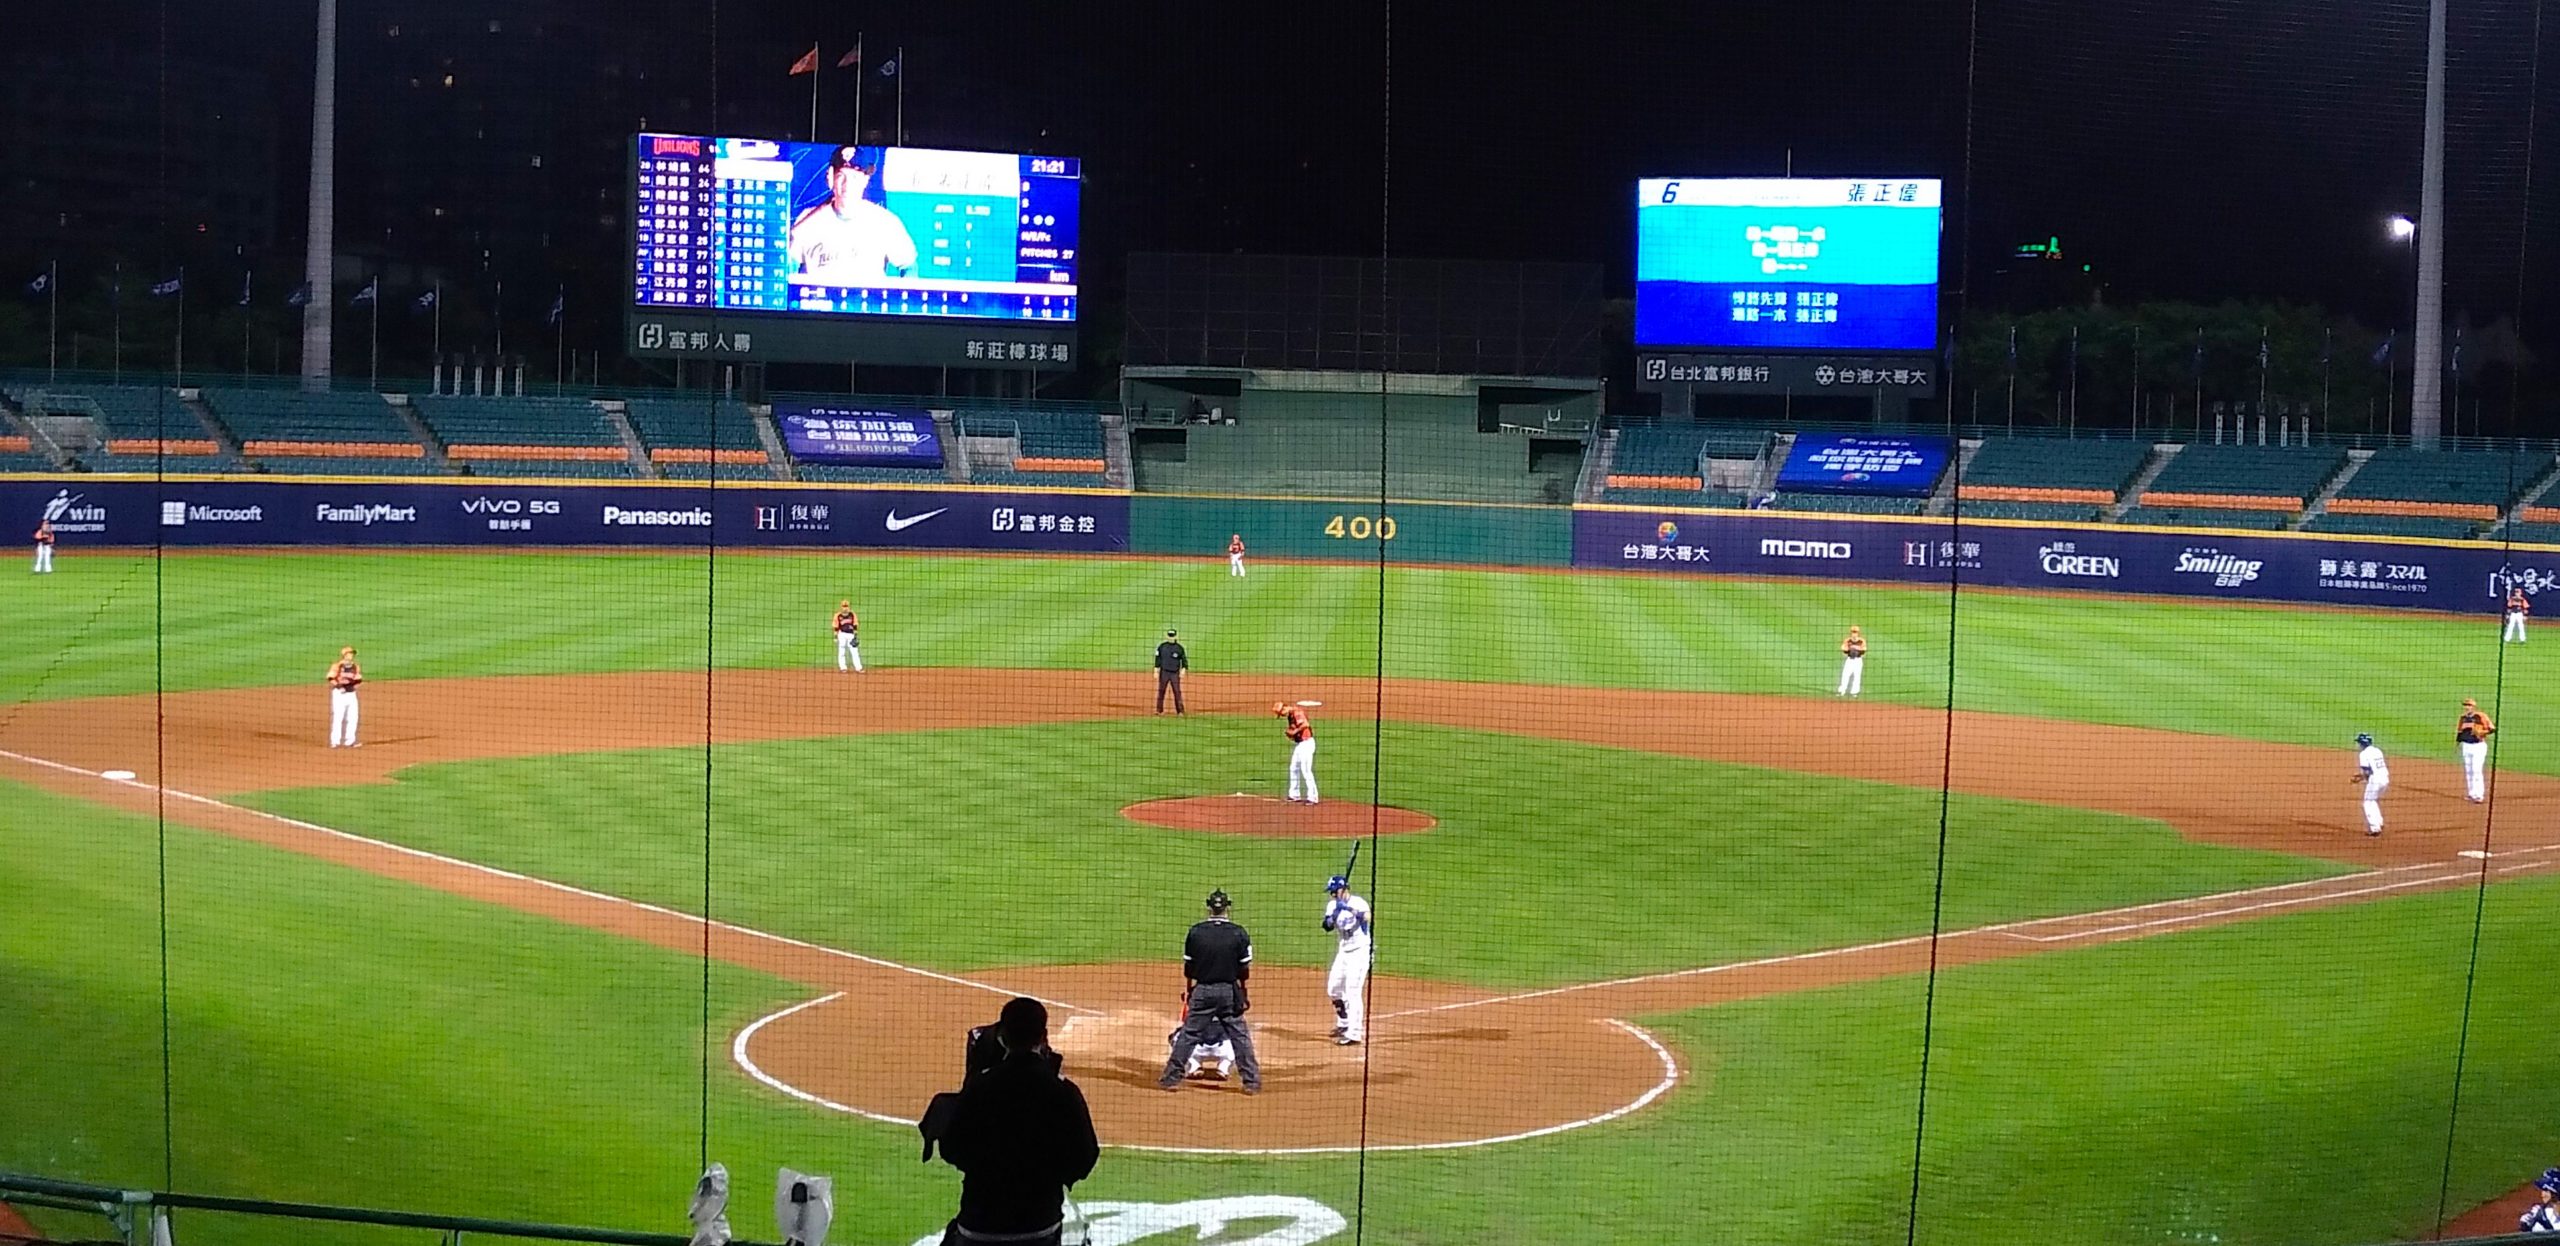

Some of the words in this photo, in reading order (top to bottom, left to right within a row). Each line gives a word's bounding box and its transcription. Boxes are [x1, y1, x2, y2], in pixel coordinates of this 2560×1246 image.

[1031, 159, 1065, 173] 21:21
[1662, 182, 1680, 203] 6
[1848, 184, 1918, 202] 張正偉
[697, 207, 709, 217] 32
[696, 249, 708, 260] 77
[1020, 247, 1058, 259] PITCHES
[1062, 250, 1074, 259] 27
[695, 279, 708, 289] 27
[1049, 269, 1070, 282] km
[695, 293, 707, 304] 37
[669, 331, 751, 352] 富邦人壽
[966, 341, 1069, 361] 新莊棒球場
[1670, 365, 1770, 383] 台北富邦銀行
[1838, 368, 1928, 385] 台灣大哥大
[70, 504, 105, 520] win
[190, 505, 262, 521] Microsoft
[317, 504, 416, 525] FamilyMart
[530, 500, 560, 514] 5G
[603, 506, 712, 525] Panasonic
[791, 505, 829, 520] 復華
[1020, 514, 1095, 533] 富邦金控
[1325, 516, 1396, 539] 400
[1622, 544, 1710, 563] 台灣大哥大
[2043, 554, 2119, 577] GREEN
[2174, 553, 2263, 580] Smiling
[2320, 559, 2377, 578] 獅美露
[2386, 565, 2427, 580] スマイル
